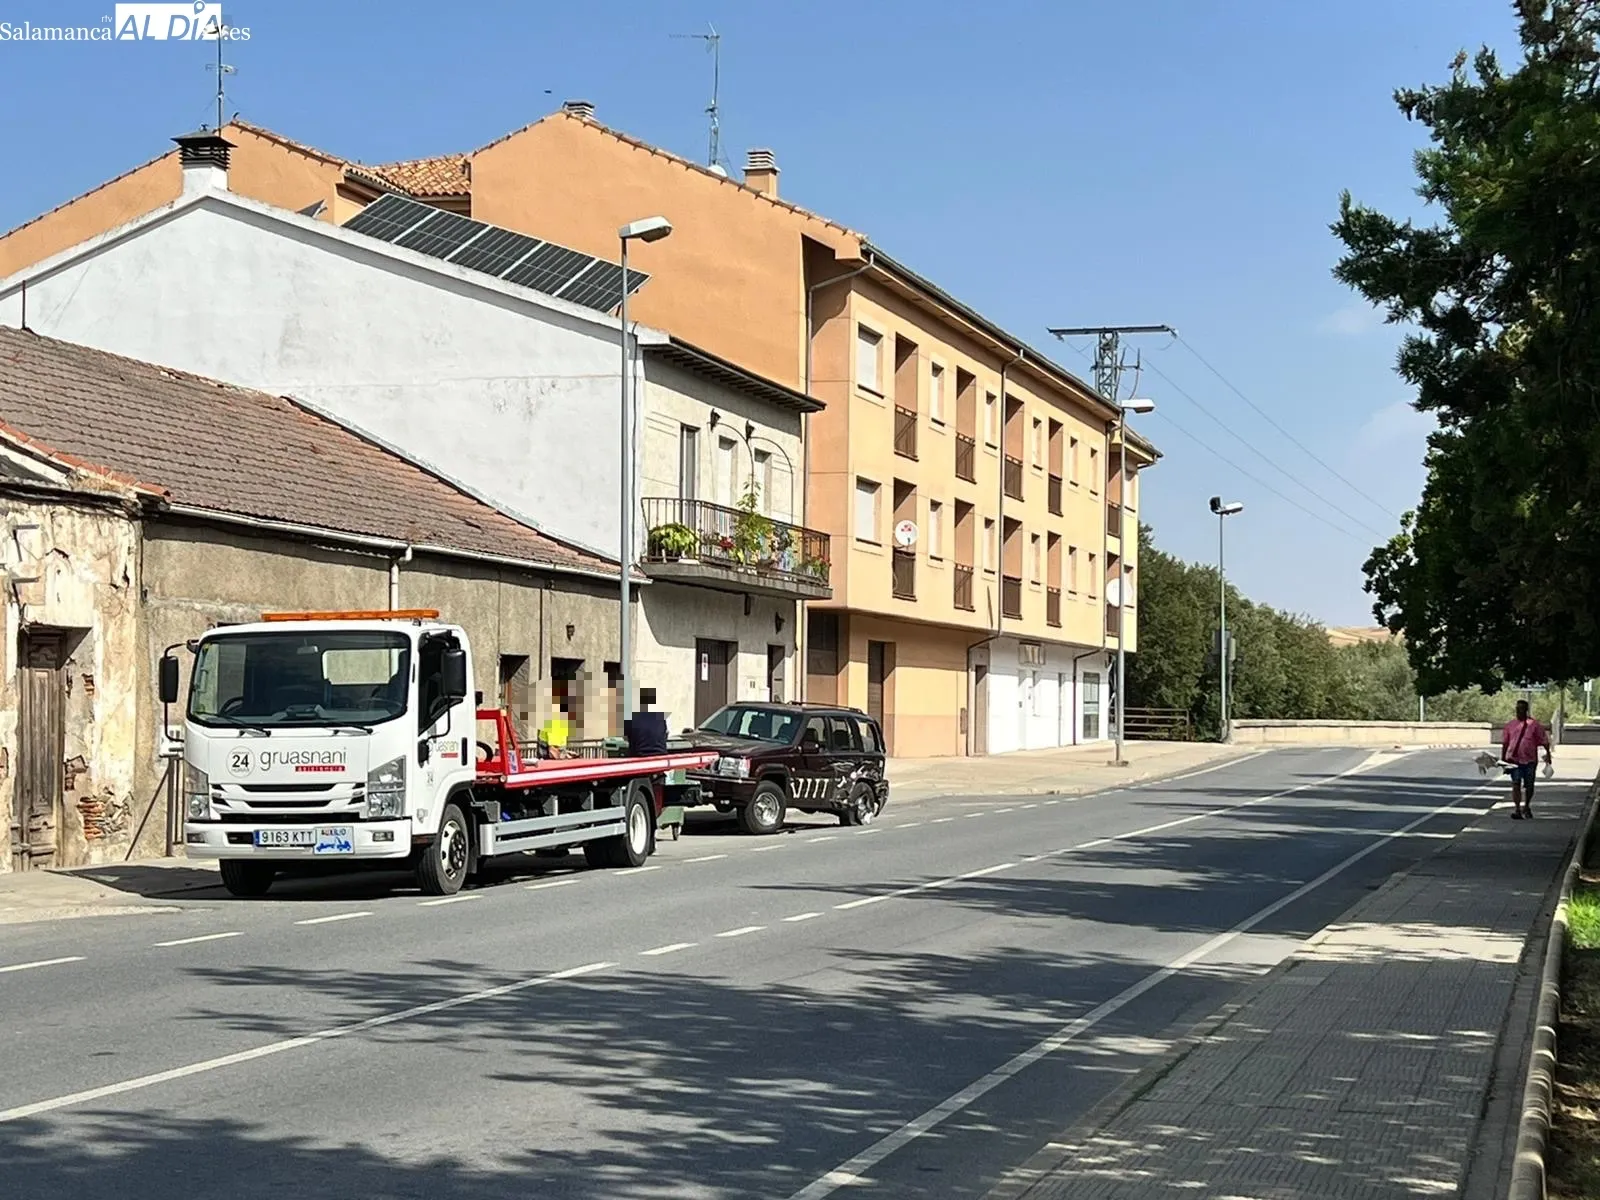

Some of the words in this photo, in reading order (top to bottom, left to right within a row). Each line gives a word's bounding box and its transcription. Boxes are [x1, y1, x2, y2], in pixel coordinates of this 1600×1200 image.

[231, 754, 249, 768] 24
[260, 747, 347, 771] gruasnani
[262, 831, 289, 843] 9163
[292, 831, 313, 842] KTT
